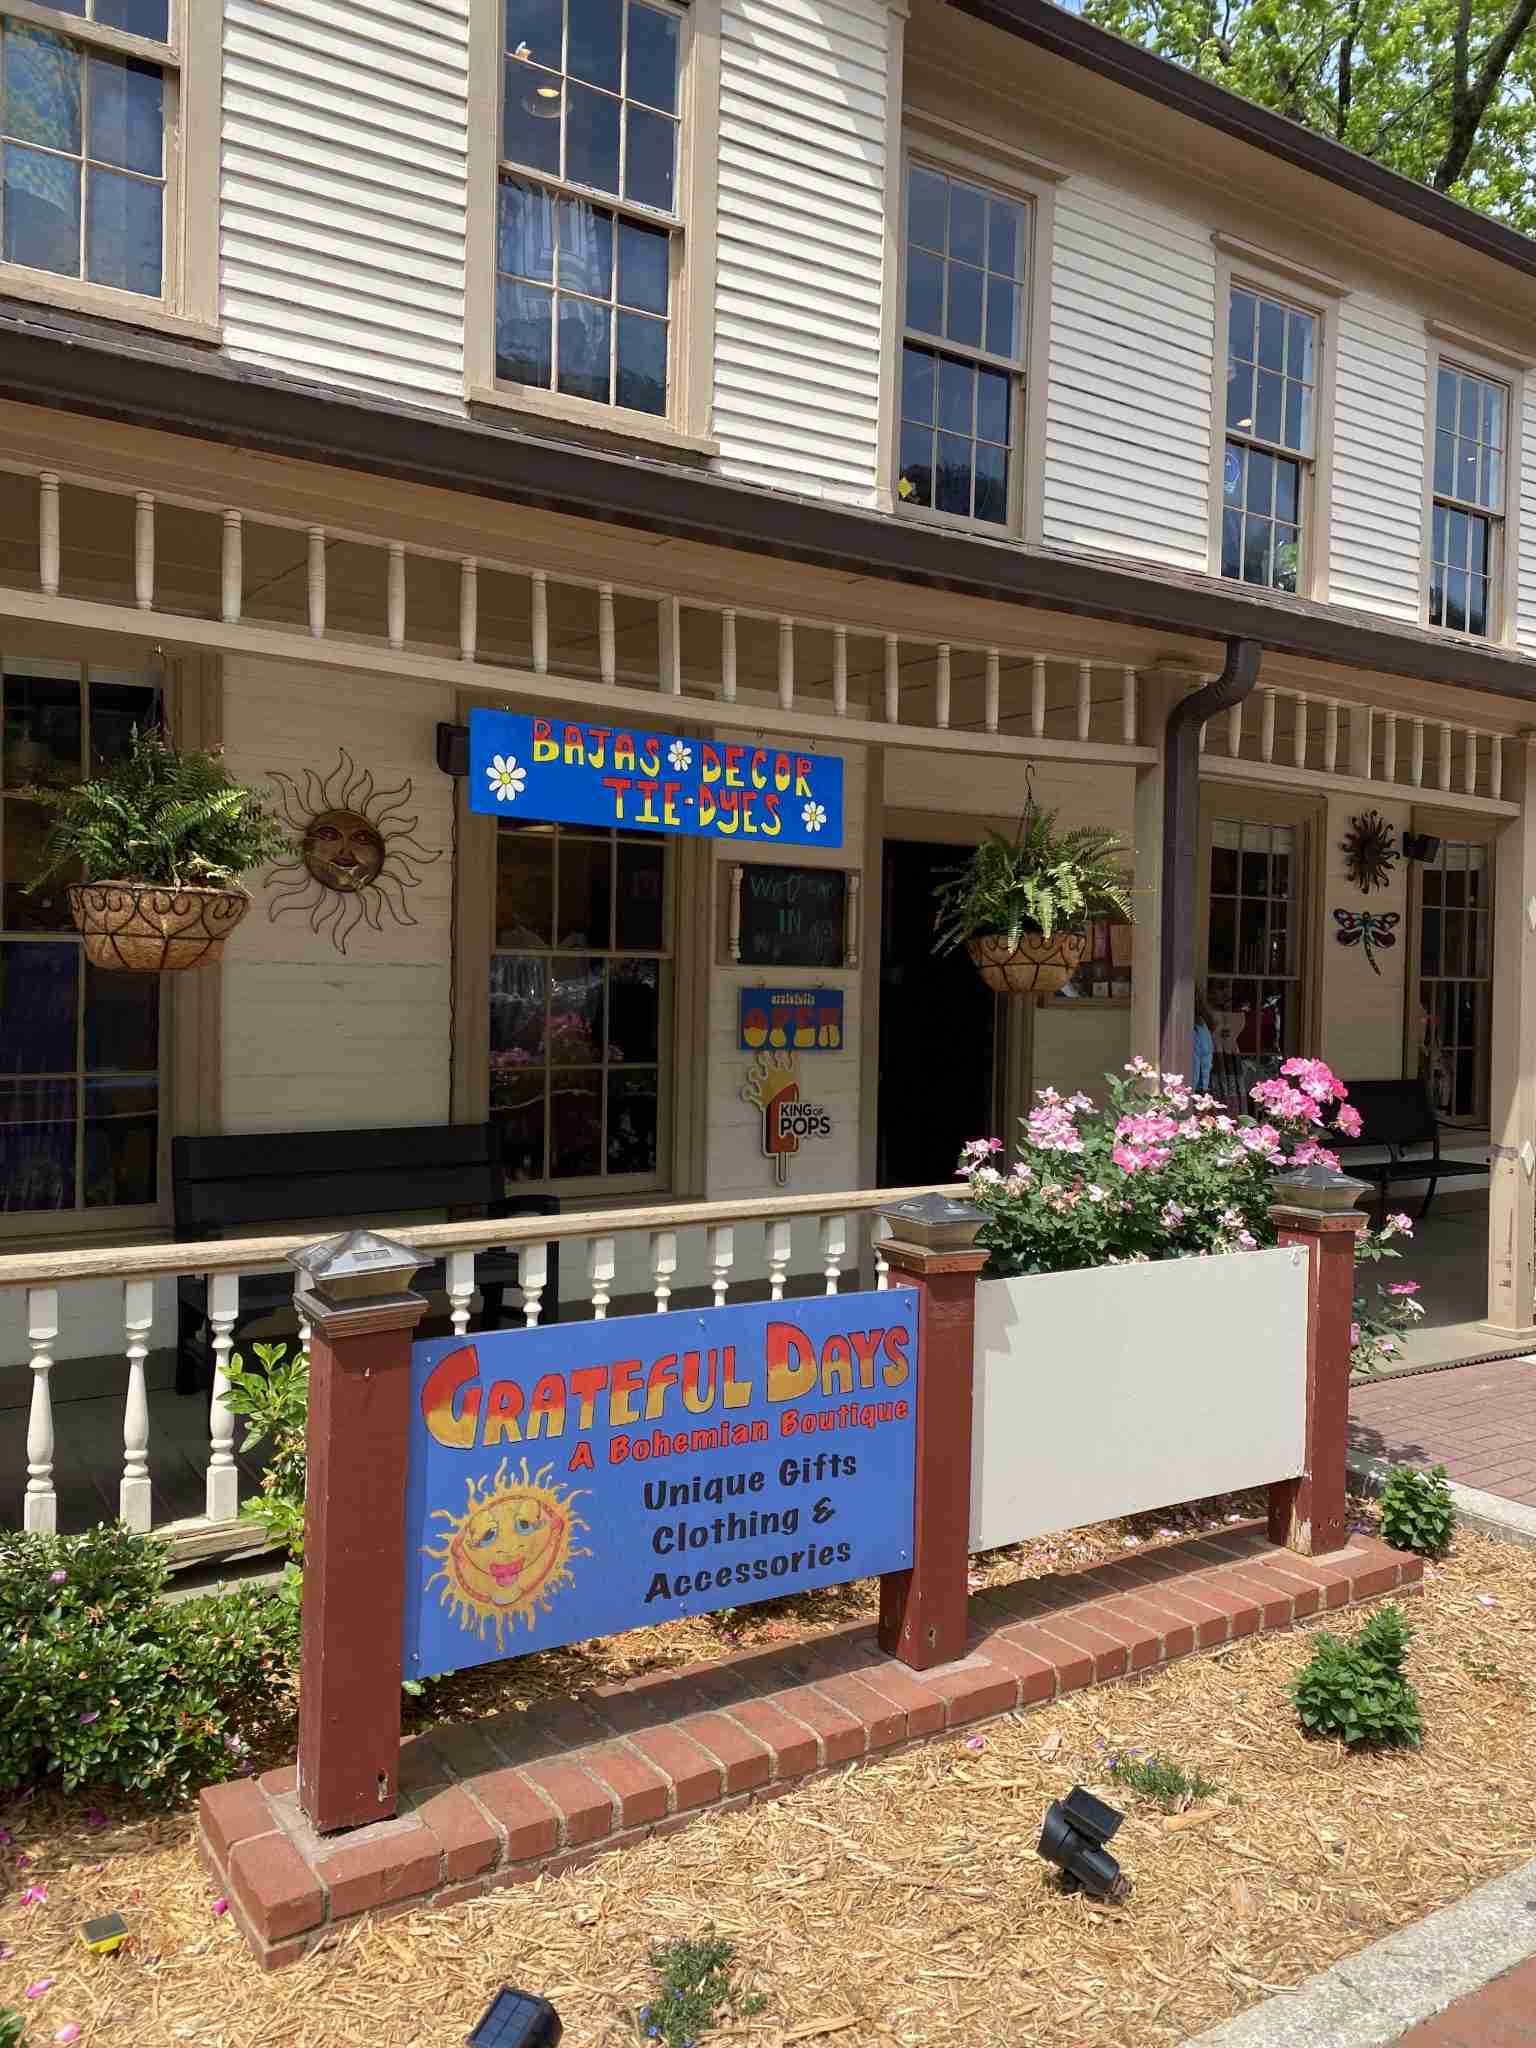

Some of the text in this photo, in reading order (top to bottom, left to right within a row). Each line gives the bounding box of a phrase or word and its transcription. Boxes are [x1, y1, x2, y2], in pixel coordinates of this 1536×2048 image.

[532, 718, 814, 798] BAJAS DECOR
[743, 1007, 841, 1048] OPEN
[780, 1103, 812, 1117] KING
[780, 1115, 831, 1137] POPS
[421, 1320, 910, 1451] GRATEFUL DAYS
[566, 1398, 910, 1473] A Bohemian Boutique
[643, 1453, 858, 1512] Unique Gifts
[652, 1497, 836, 1556] Clothing &
[643, 1539, 852, 1603] Accessories
